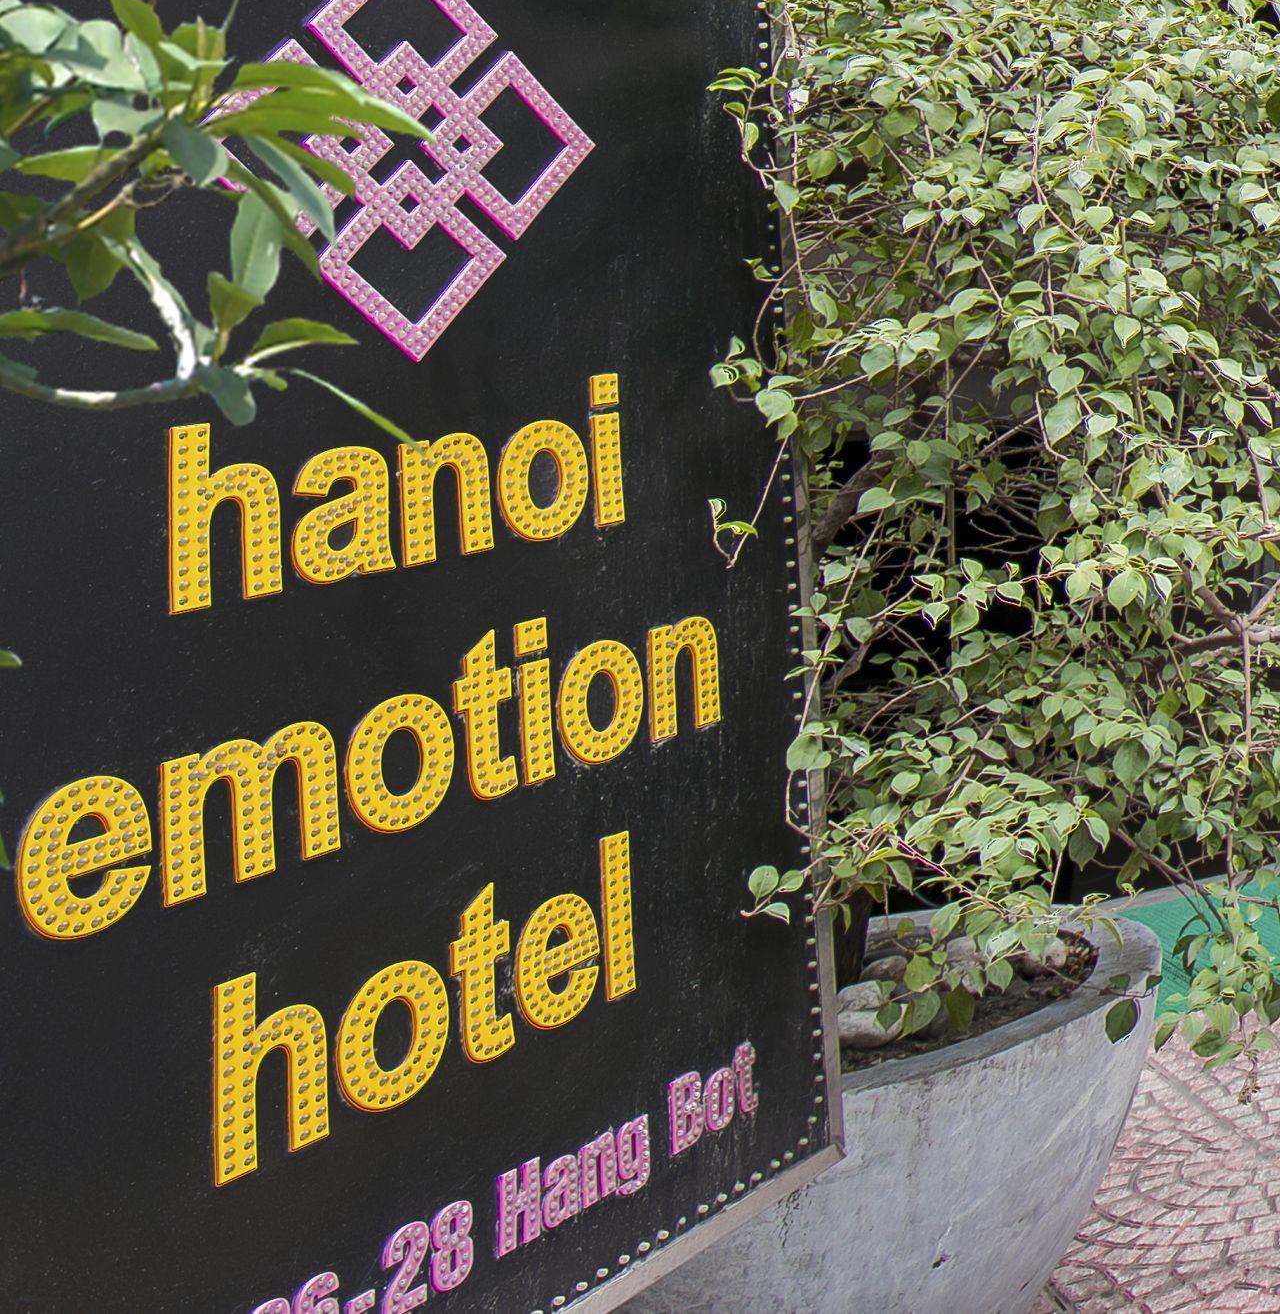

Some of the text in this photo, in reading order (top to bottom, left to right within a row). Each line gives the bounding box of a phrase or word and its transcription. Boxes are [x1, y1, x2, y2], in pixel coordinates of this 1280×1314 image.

[168, 372, 626, 615] hanoi
[17, 615, 722, 940] emotion
[213, 830, 637, 1187] hotel
[252, 1039, 760, 1314] -28 Hang Bot
